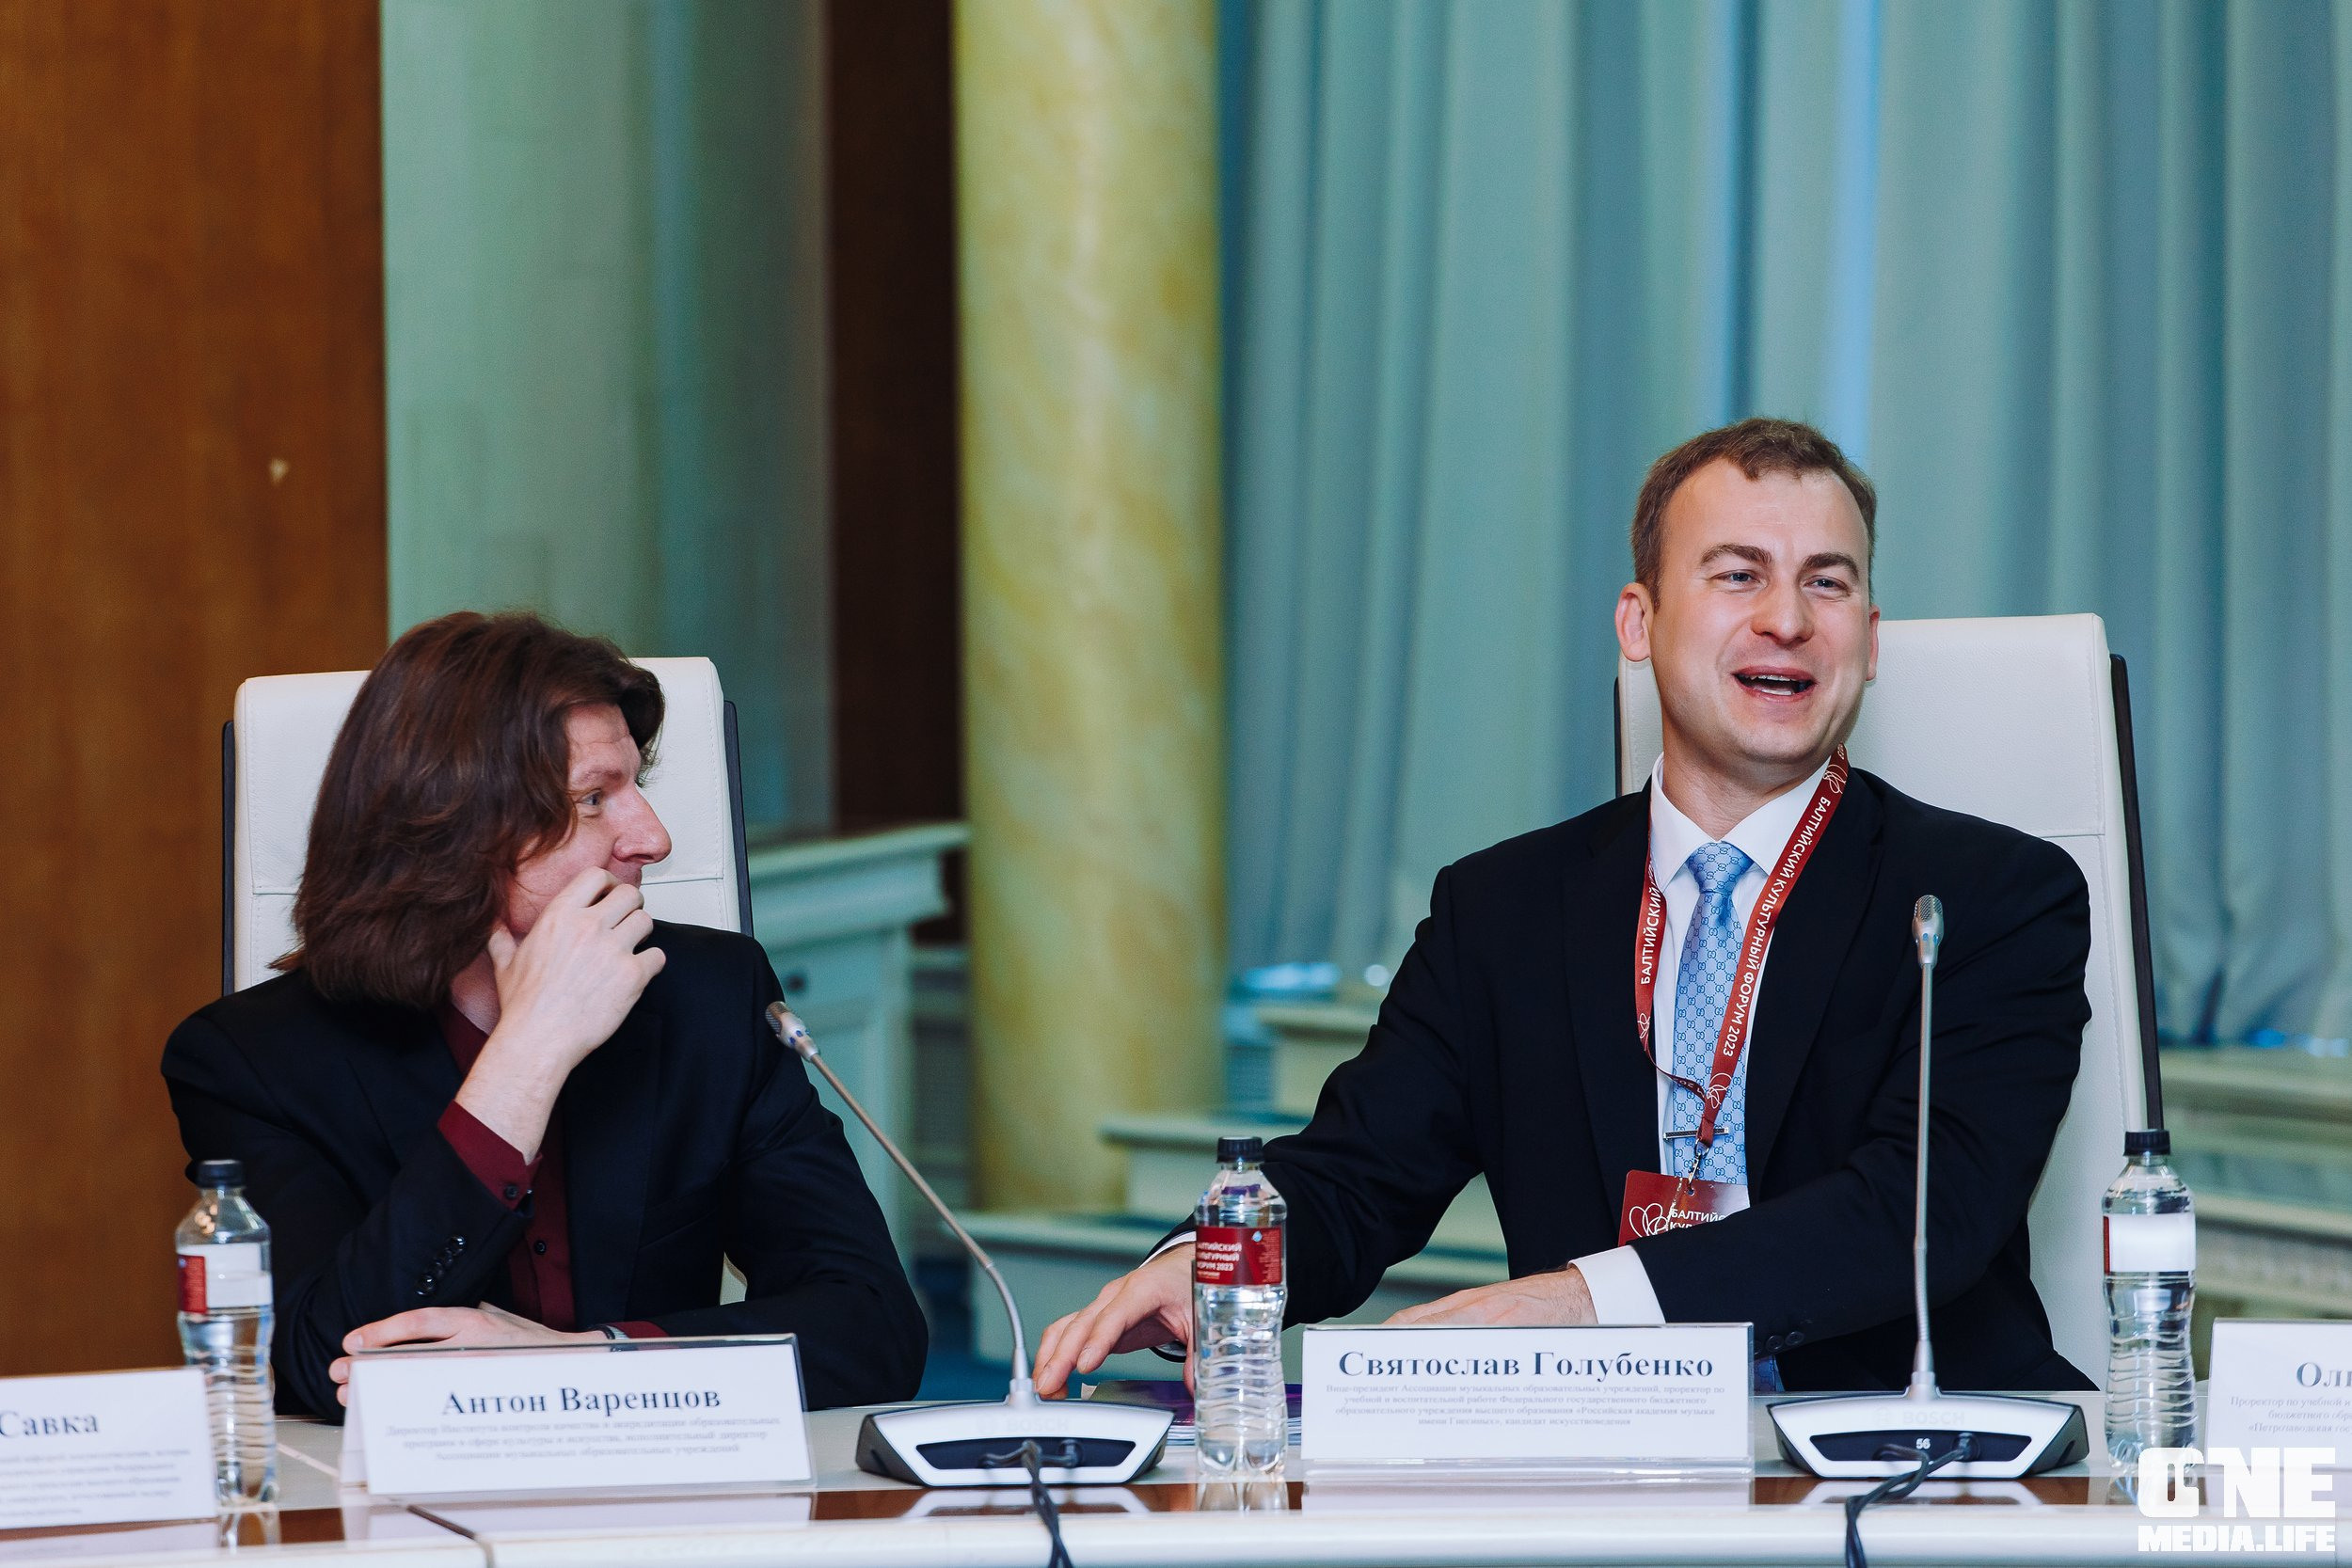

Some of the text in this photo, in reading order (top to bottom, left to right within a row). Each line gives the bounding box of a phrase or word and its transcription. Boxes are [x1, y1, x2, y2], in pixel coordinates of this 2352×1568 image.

[1640, 887, 1661, 985] БАЛТИЙСКИЙ
[1723, 796, 1832, 1057] БАЛТИЙСКИЙ КУЛЬТУРНЫЙ ФОРУМ 2023
[1339, 1352, 1713, 1383] Святослав Голубенко
[441, 1387, 721, 1417] Антон Варенцов
[0, 1412, 100, 1437] Савка
[1915, 1437, 1931, 1449] 56
